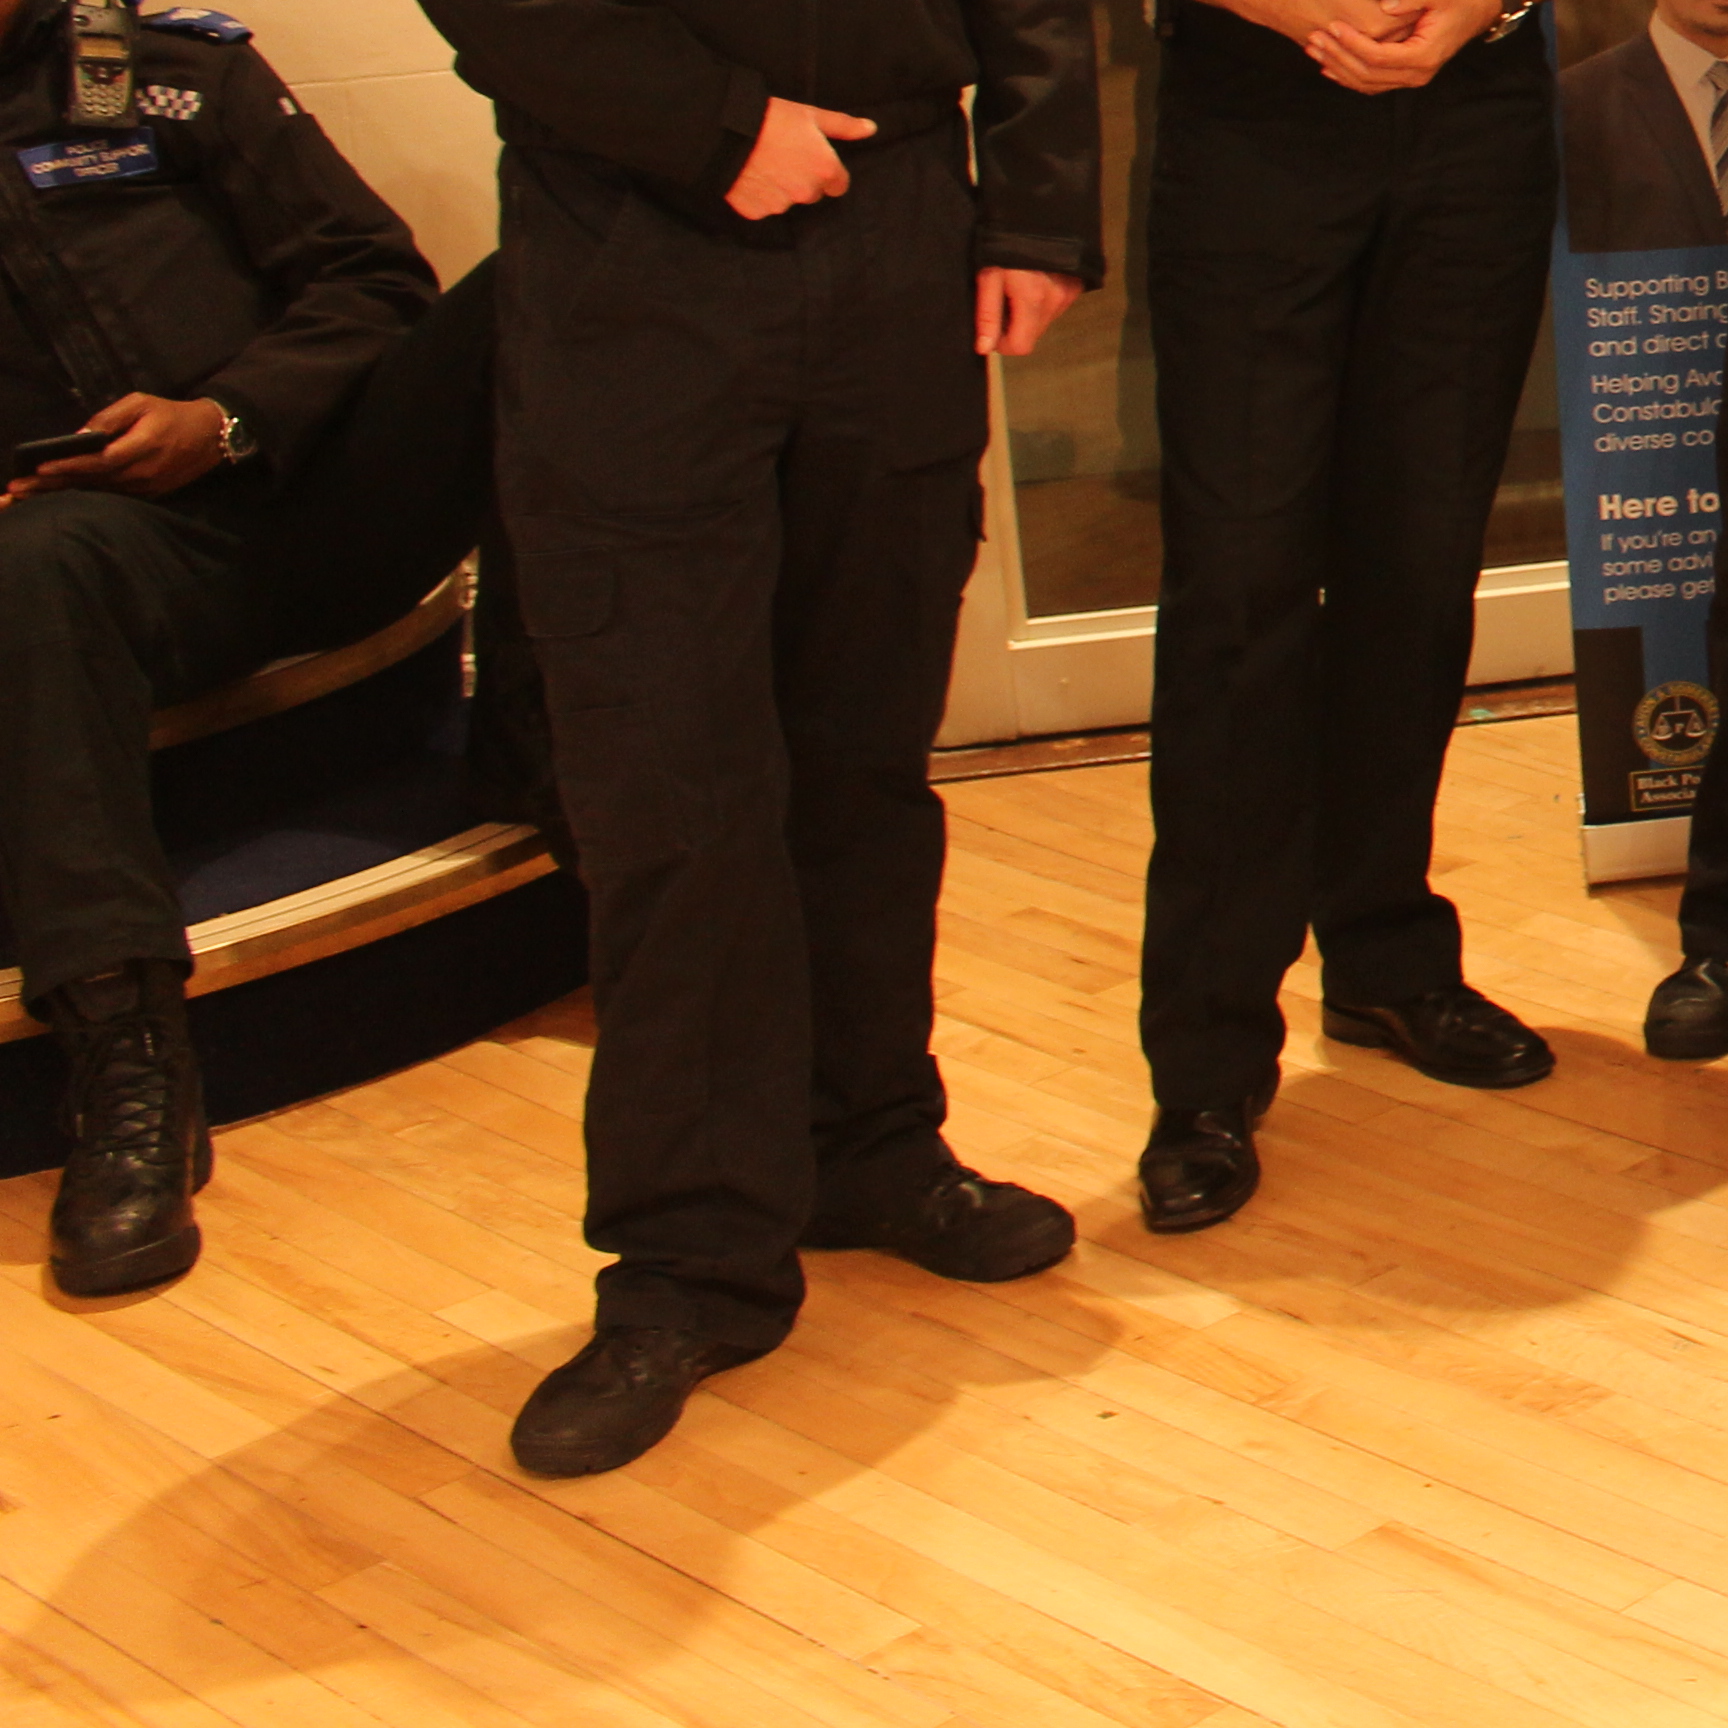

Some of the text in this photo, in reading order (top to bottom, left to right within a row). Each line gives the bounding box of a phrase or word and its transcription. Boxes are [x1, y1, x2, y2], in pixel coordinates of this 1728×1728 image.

[1584, 273, 1710, 301] Supporting
[1586, 305, 1643, 328] Staff.
[1588, 335, 1638, 358] and
[1642, 331, 1710, 355] direct
[1590, 373, 1680, 396] Helping
[1593, 432, 1677, 453] diverse
[1597, 488, 1721, 521] Here to
[1617, 529, 1683, 553] you're
[1602, 558, 1663, 577] some
[1603, 582, 1677, 605] please
